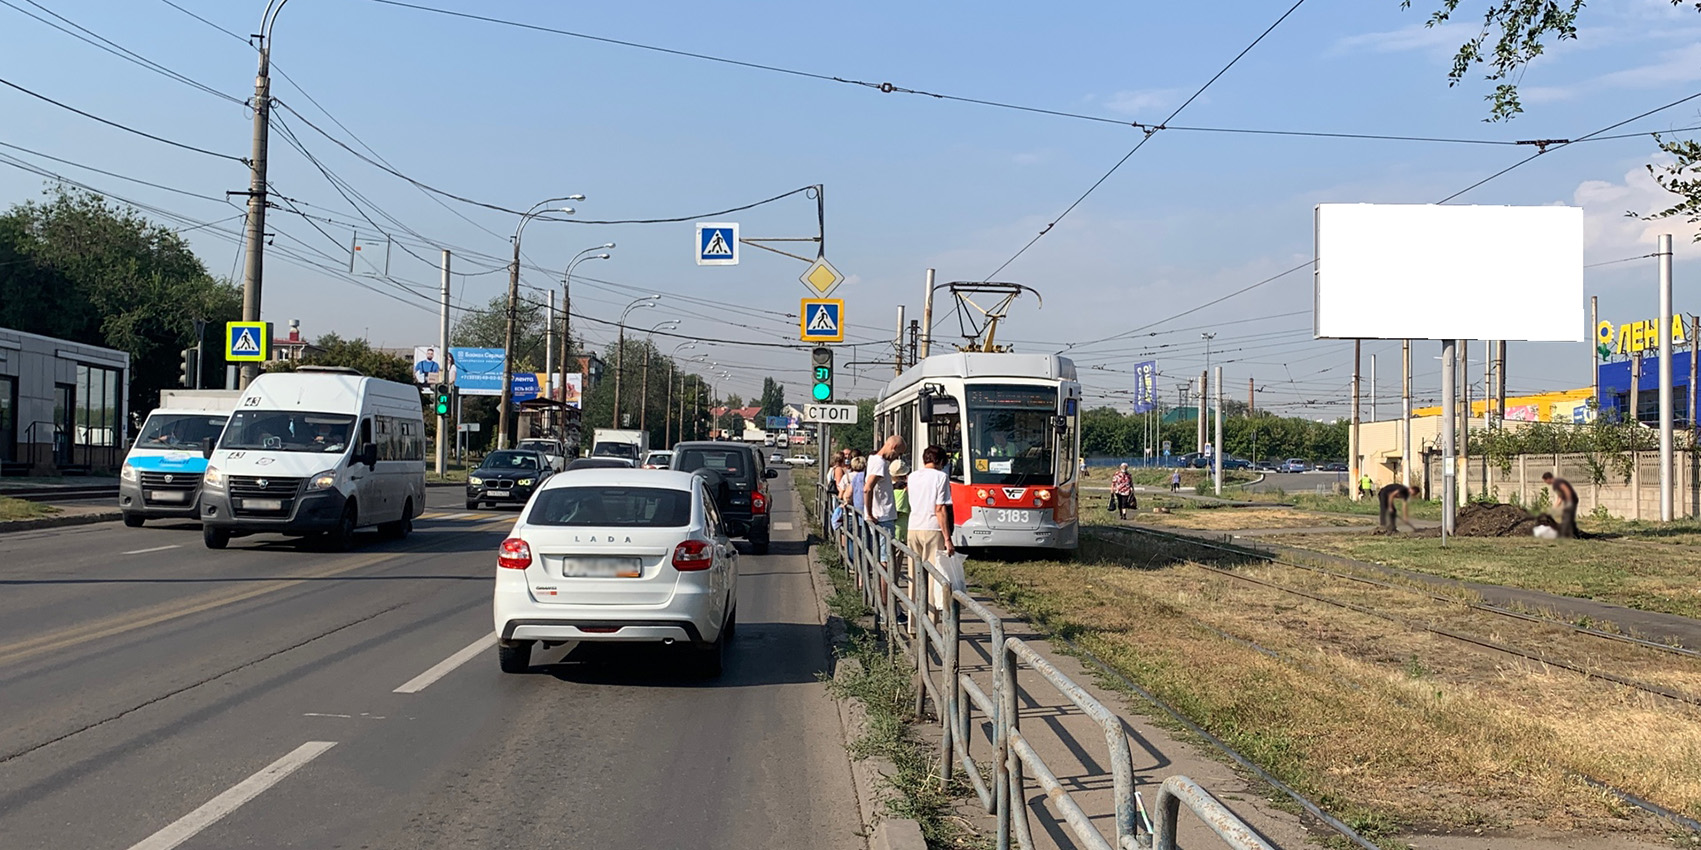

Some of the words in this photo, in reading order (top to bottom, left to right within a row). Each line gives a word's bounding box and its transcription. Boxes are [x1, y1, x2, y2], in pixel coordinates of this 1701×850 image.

[1616, 314, 1686, 354] ЛЕНА
[816, 368, 829, 379] 37
[809, 406, 849, 420] СТОП
[997, 510, 1029, 523] 3183
